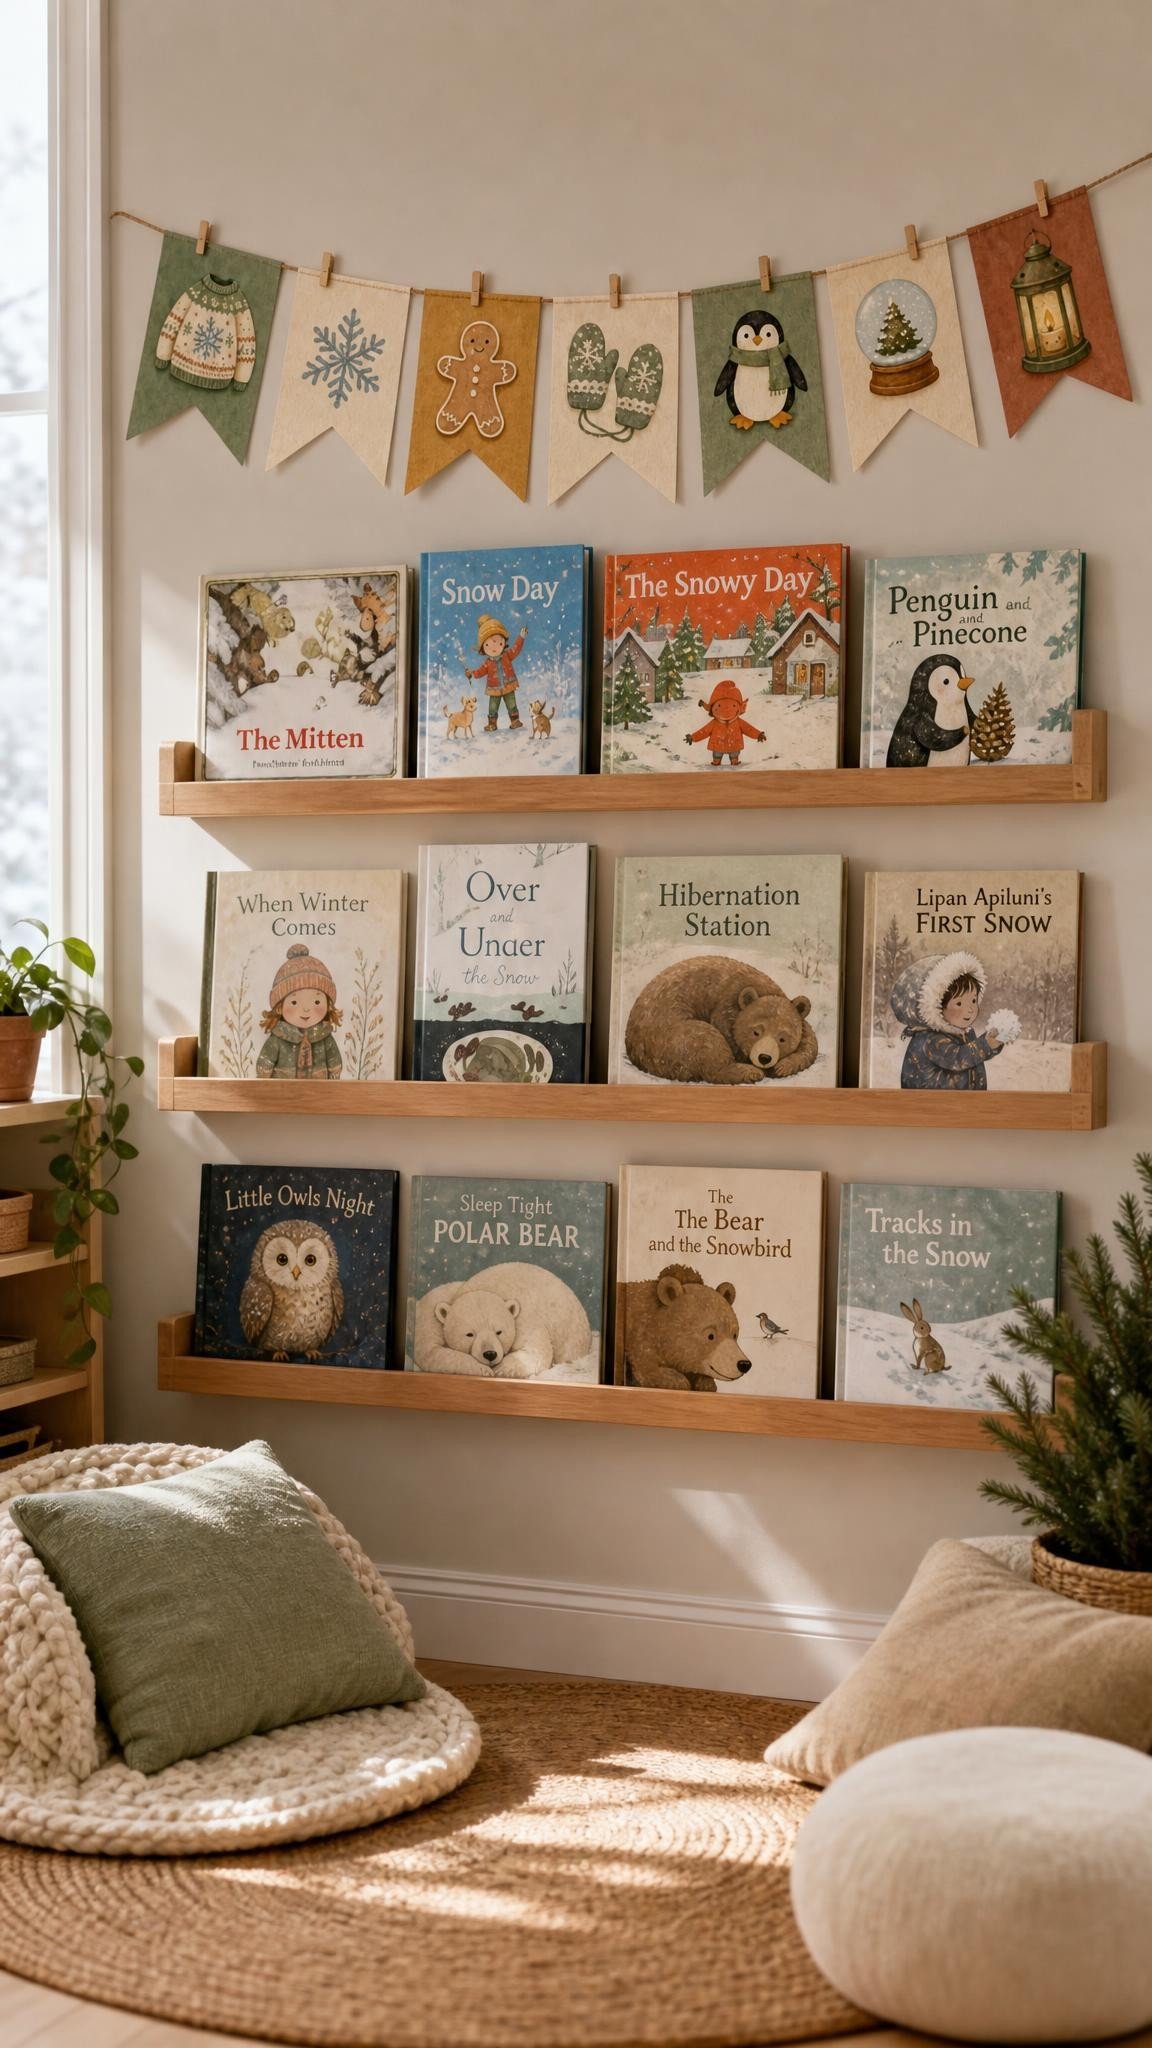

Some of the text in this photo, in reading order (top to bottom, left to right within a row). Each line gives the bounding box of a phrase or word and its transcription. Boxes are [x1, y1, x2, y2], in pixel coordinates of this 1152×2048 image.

[442, 575, 559, 608] Snow Day
[625, 567, 814, 600] The Snowy Day
[889, 585, 1031, 621] Penguin and
[913, 621, 1027, 647] Pinecone
[237, 727, 364, 750] The Mitten
[466, 871, 540, 902] Over
[659, 882, 800, 906] Hibernation
[237, 892, 368, 914] When Winter
[917, 888, 1052, 912] Lipan Apiluni's
[272, 918, 336, 936] Comes
[490, 908, 514, 922] and
[685, 912, 771, 936] Station
[462, 964, 540, 985] the Snow
[225, 1185, 375, 1218] Little Owls Night
[460, 1194, 552, 1220] Sleep Tight
[708, 1189, 733, 1203] The
[675, 1209, 764, 1231] The Bear
[865, 1208, 972, 1236] Tracks in
[434, 1220, 580, 1248] POLAR BEAR
[649, 1236, 792, 1258] and the Snowbird
[882, 1241, 991, 1268] the Snow
